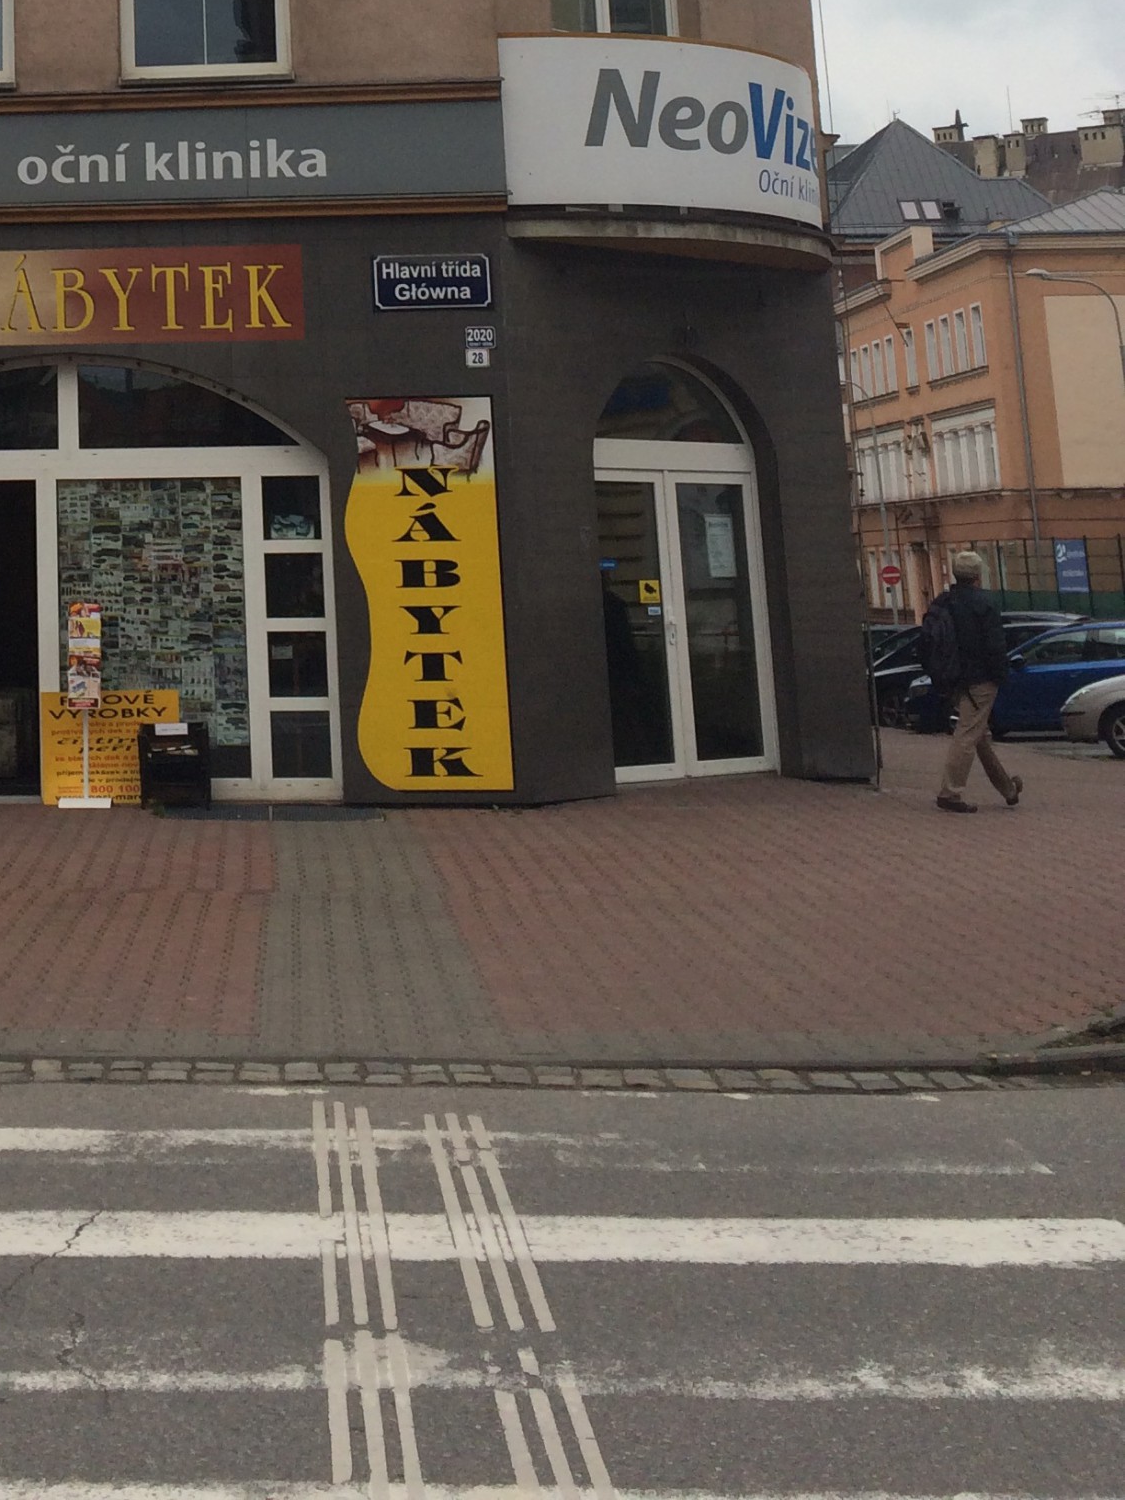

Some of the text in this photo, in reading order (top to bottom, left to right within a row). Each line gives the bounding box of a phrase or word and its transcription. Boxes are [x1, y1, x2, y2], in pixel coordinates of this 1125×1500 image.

[17, 138, 328, 185] oční klinika
[759, 169, 795, 198] Oční
[382, 260, 481, 279] Hlavní třída
[395, 282, 471, 300] Główna
[467, 329, 493, 341] 2020
[472, 352, 484, 364] 28
[393, 465, 484, 778] NÁBYTEK
[91, 785, 114, 793] 800
